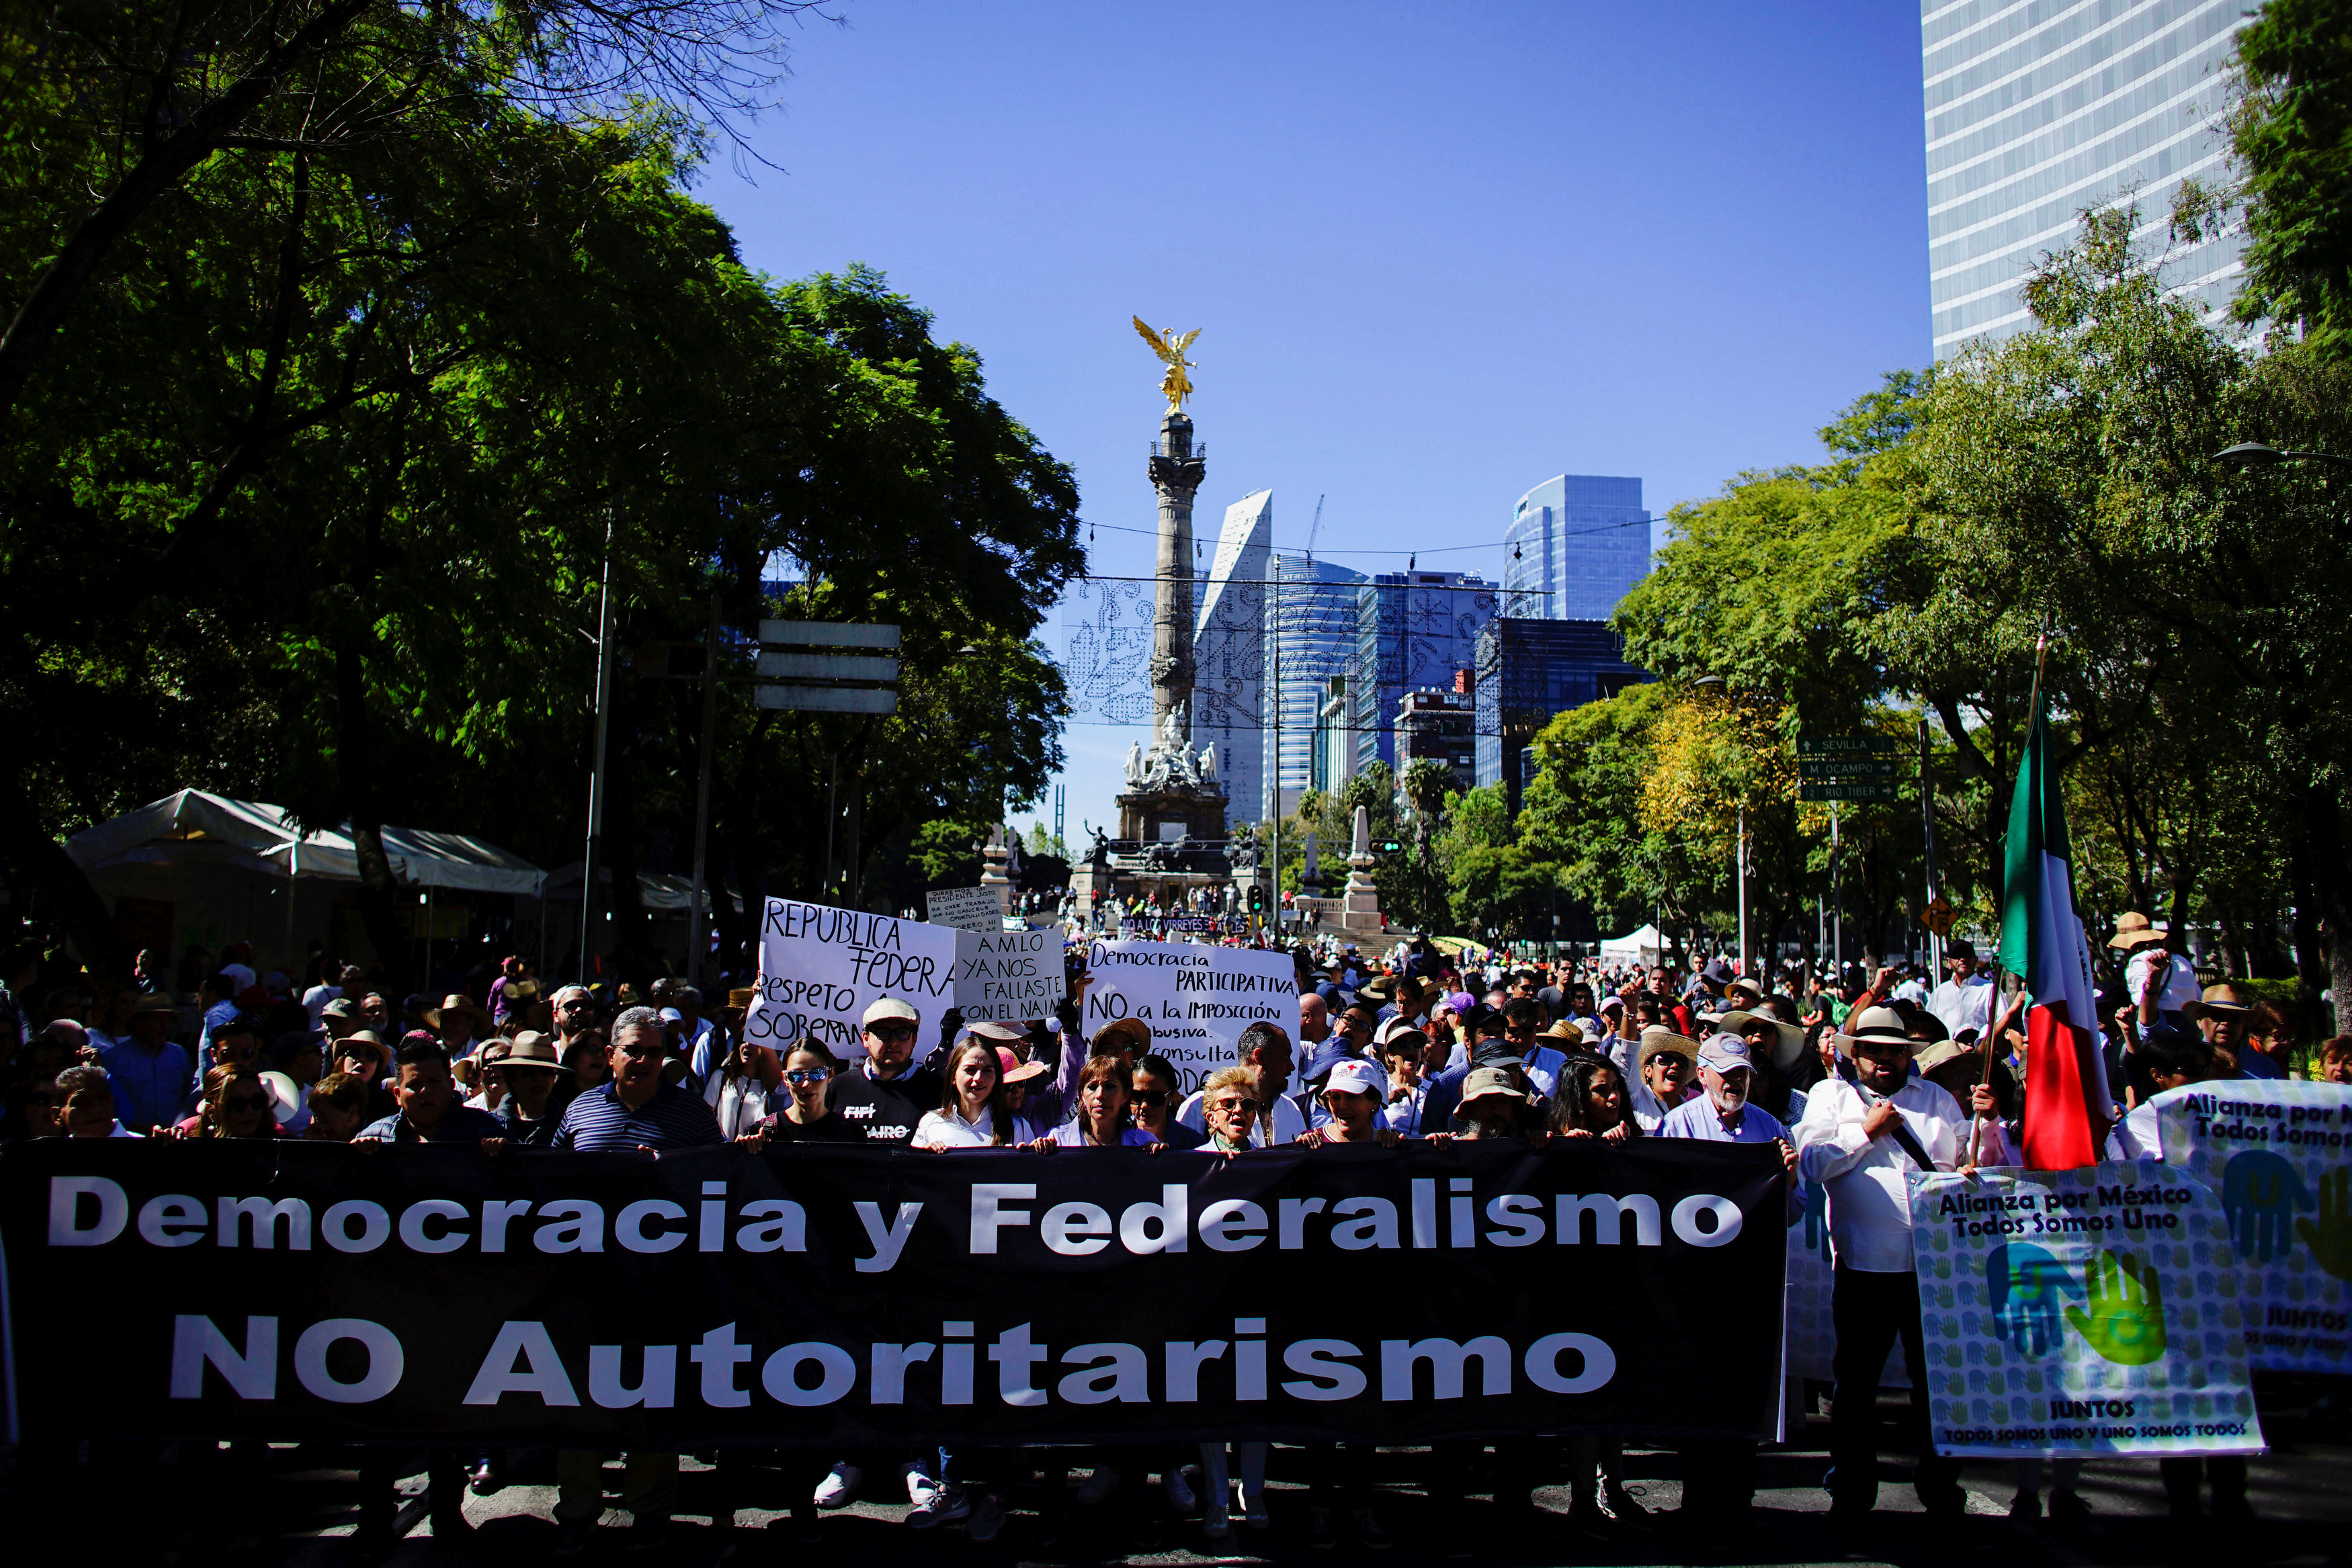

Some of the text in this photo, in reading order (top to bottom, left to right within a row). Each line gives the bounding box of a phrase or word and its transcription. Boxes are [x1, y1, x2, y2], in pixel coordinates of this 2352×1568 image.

[1822, 740, 1867, 750] SEVILLA
[1810, 764, 1874, 773] M OCAMPO
[1825, 787, 1842, 797] RIO
[1848, 787, 1876, 797] TIBER
[929, 892, 974, 904] PRESIDENTE
[932, 887, 970, 897] QUEREMOS
[958, 906, 989, 914] CANCELE
[765, 900, 900, 951] REPÚBLICA
[1123, 918, 1136, 930] NO
[1137, 919, 1144, 930] A
[1163, 918, 1202, 931] VIRREYES
[978, 934, 1043, 953] AMLO
[1090, 943, 1210, 967] Democracia
[962, 958, 1037, 980] YA NOS
[984, 975, 1062, 1000] FALLASTE
[1176, 969, 1298, 1000] PARTICIPATIVA,
[960, 996, 1062, 1020] CON EL NAIM
[1089, 992, 1128, 1019] NO
[1137, 1004, 1152, 1019] a
[1163, 1000, 1181, 1019] la
[2184, 1093, 2282, 1119] Alianza
[2291, 1106, 2333, 1125] por
[2195, 1116, 2269, 1141] Todos
[1939, 1184, 2192, 1216] Alianza por México
[48, 1176, 1745, 1273] Democracia y Federalismo
[1953, 1209, 2178, 1237] Todos Somos Uno
[2267, 1307, 2347, 1330] JUNTOS
[2263, 1333, 2297, 1347] UNO
[169, 1315, 1616, 1408] NO Autoritarismo
[2050, 1401, 2135, 1420] JUNTOS
[1945, 1423, 2247, 1442] TODOS SOMOS UNO Y UNO SOMOS TODOS
